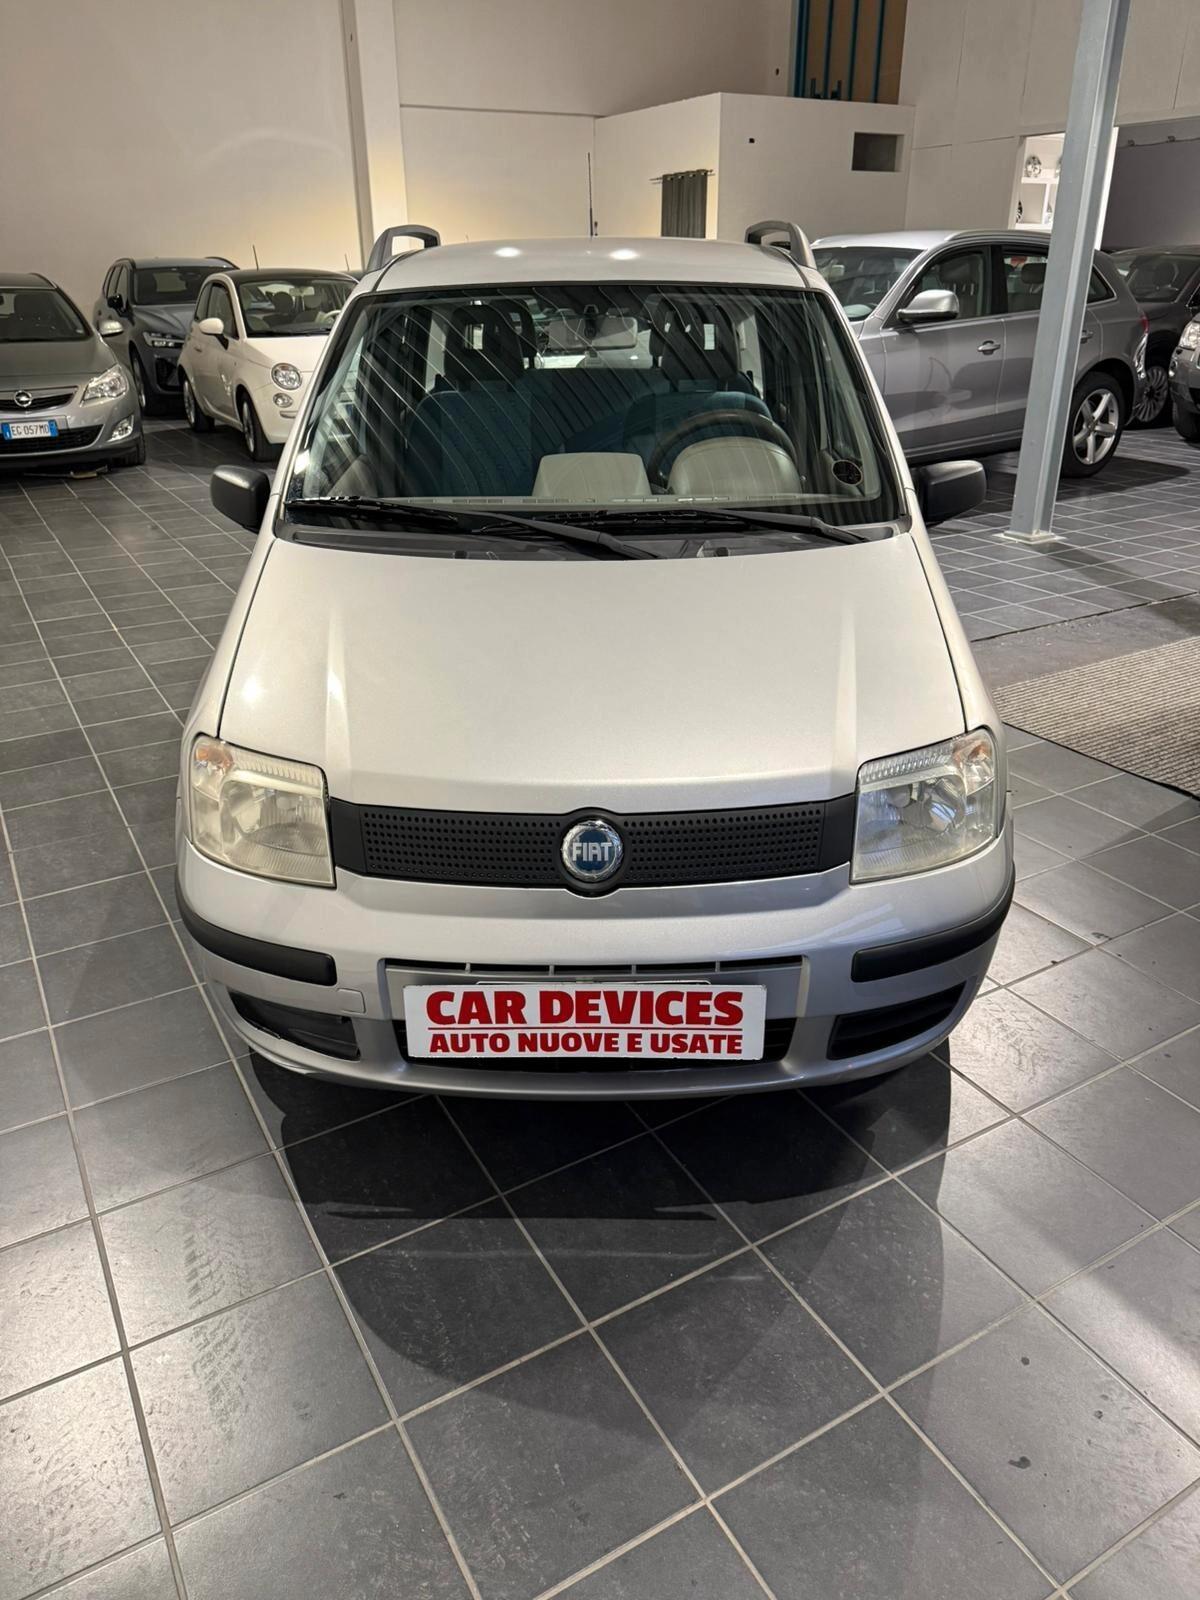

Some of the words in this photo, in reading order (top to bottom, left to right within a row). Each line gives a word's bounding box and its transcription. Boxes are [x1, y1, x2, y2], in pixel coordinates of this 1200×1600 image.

[572, 842, 612, 861] FIAT
[426, 991, 526, 1025] CAR
[540, 990, 743, 1026] DEVICES
[430, 1033, 510, 1053] AUTO
[518, 1032, 620, 1053] NUOVE
[627, 1033, 642, 1053] E
[650, 1034, 742, 1054] USATE
